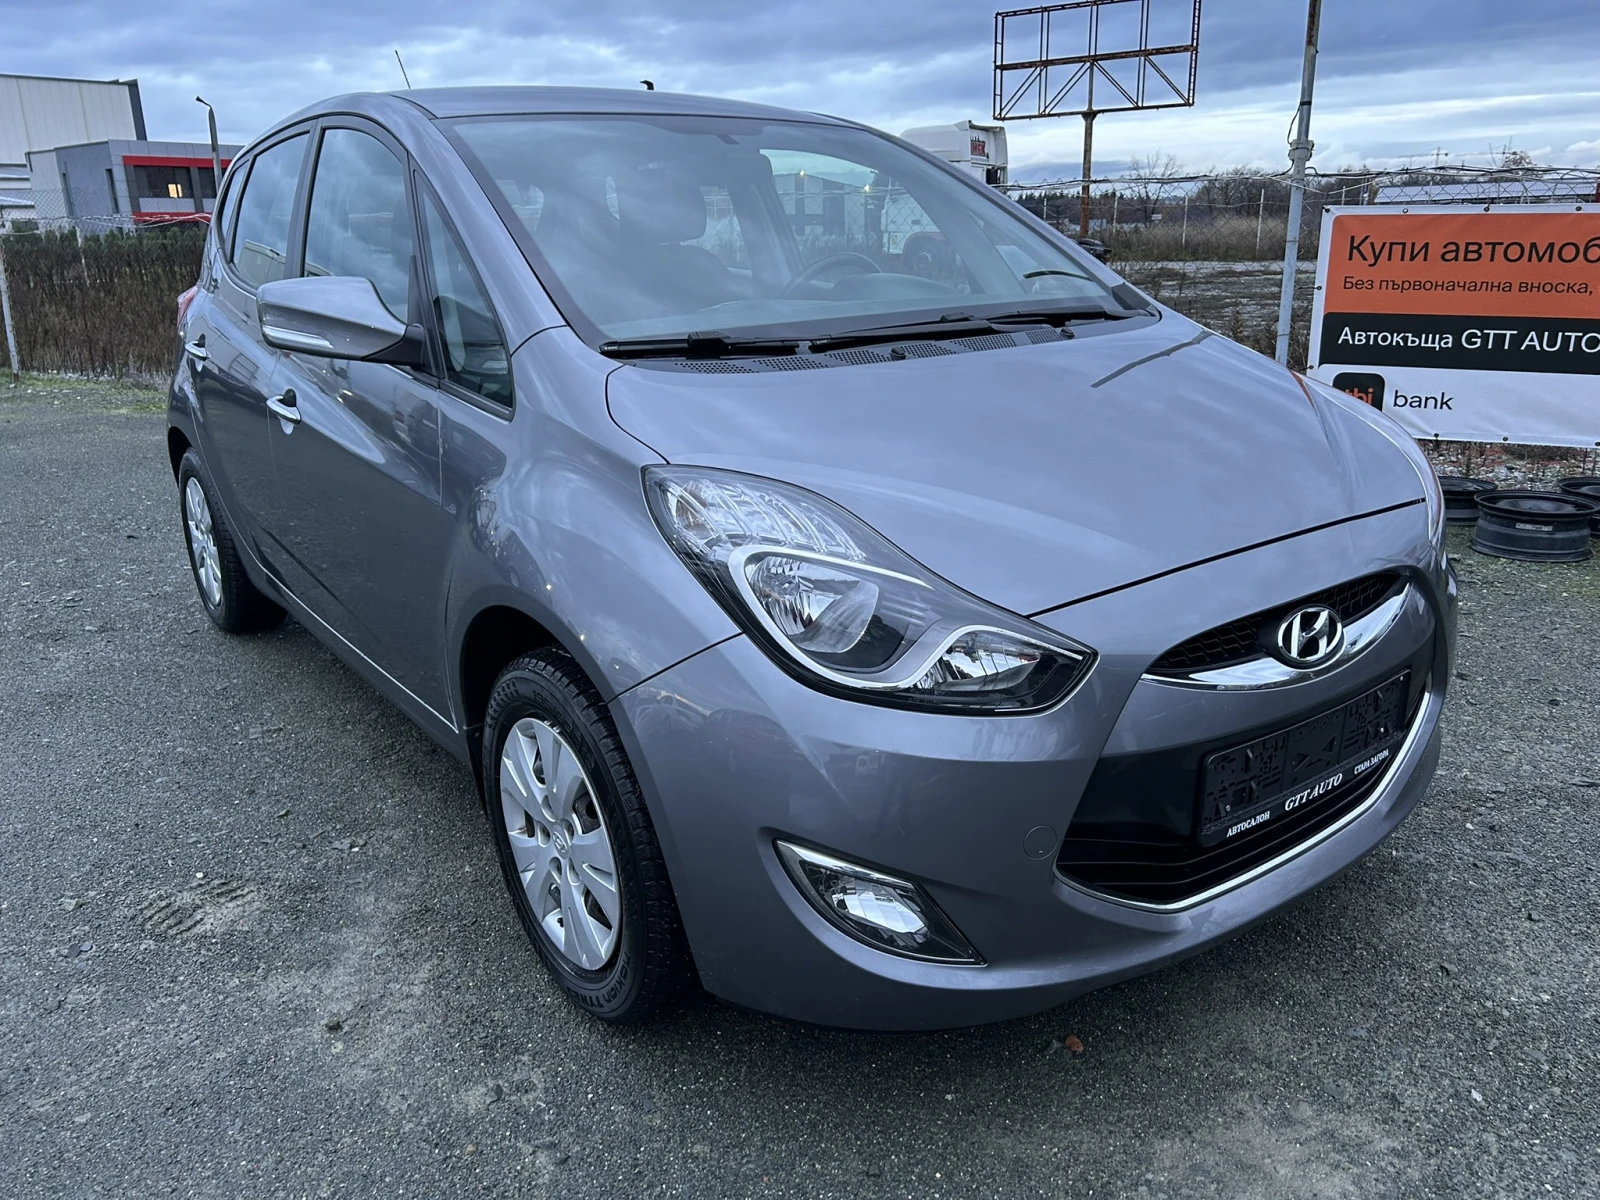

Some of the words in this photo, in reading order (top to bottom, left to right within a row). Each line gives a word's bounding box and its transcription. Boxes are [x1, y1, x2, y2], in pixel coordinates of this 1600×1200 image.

[1347, 235, 1430, 267] Купи
[1440, 236, 1600, 264] автомоб
[1343, 276, 1375, 291] Без
[1378, 279, 1513, 294] първоначална
[1518, 281, 1593, 297] вноска,
[1337, 326, 1453, 351] Автокъща
[1461, 329, 1518, 350] GTT
[1520, 331, 1600, 353] AUTO
[1393, 389, 1454, 411] bank
[1226, 810, 1271, 838] АВТОСАЛОН
[1284, 790, 1311, 811] GTT
[1308, 772, 1343, 800] AUTO
